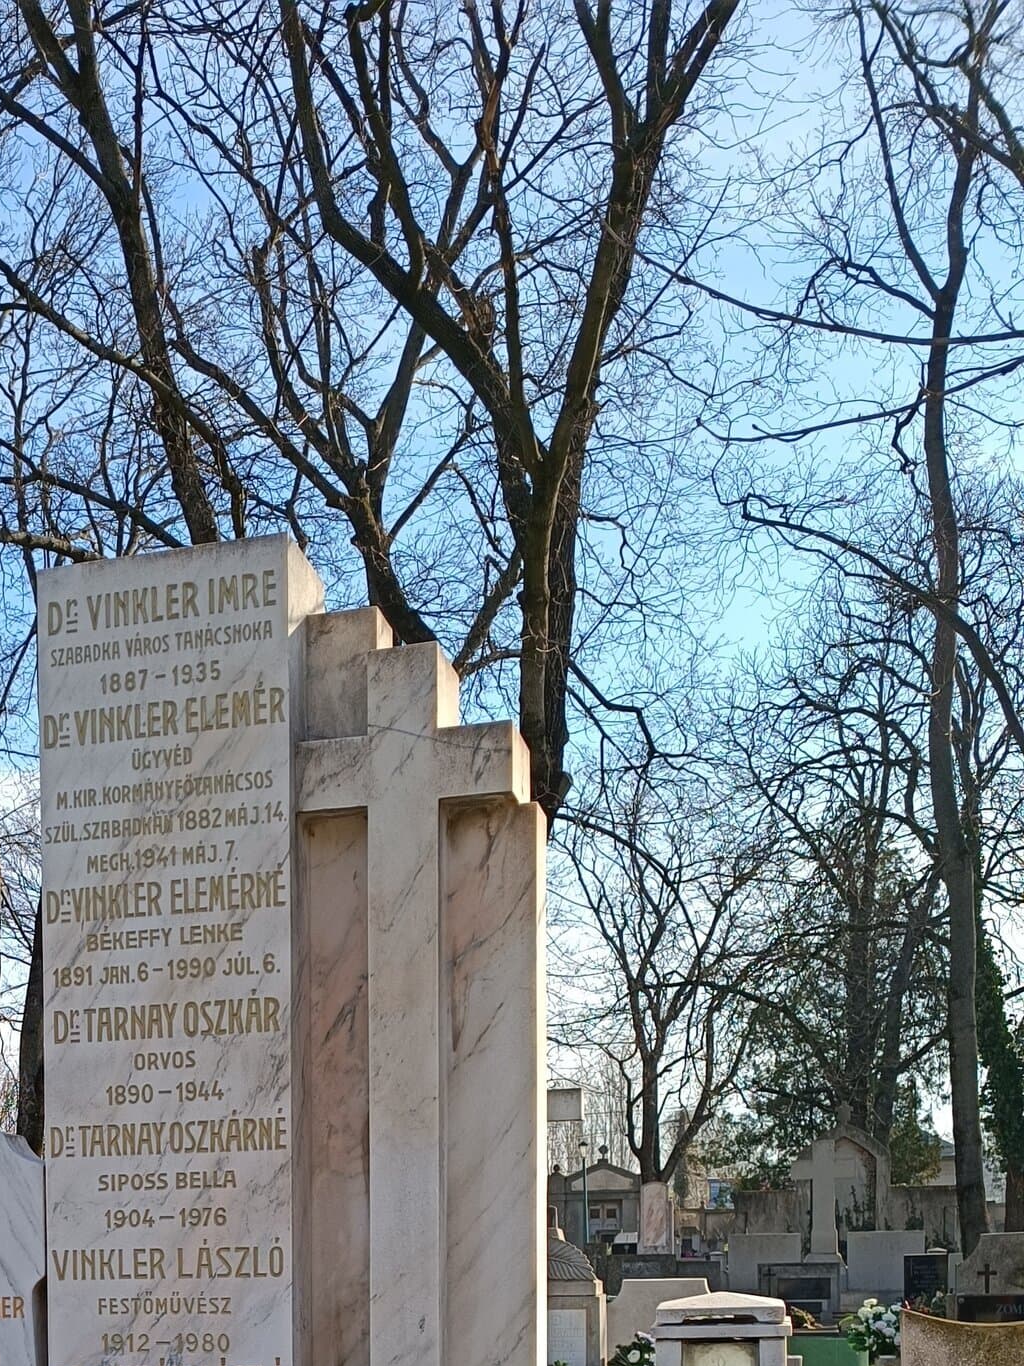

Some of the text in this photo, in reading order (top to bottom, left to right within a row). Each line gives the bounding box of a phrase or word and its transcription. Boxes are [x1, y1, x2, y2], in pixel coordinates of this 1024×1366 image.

[86, 581, 200, 631] VINKLER
[208, 570, 277, 615] IMRE
[50, 620, 273, 667] SZABADKA VÁROS TANÁCSNOKA
[100, 669, 148, 695] 1887
[172, 660, 221, 686] 1935
[74, 700, 179, 746] VINKLER
[184, 681, 286, 733] ELEMÉR
[132, 744, 193, 770] ÜGYVÉD
[177, 808, 222, 832] 1882
[71, 881, 163, 924] VINKLER
[170, 862, 287, 916] ELEMÉRNÉ
[86, 922, 244, 952] BÉKEFFY LENKE
[53, 966, 93, 988] 1891
[167, 957, 217, 980] 1990
[83, 1003, 178, 1042] TARNAY
[183, 988, 281, 1038] OSZKÁR
[134, 1050, 196, 1071] ORVOS
[106, 1084, 154, 1106] 1890
[176, 1080, 224, 1101] 1944
[78, 1122, 166, 1157] TARNAY
[169, 1108, 288, 1154] OSZKÁRNÉ
[98, 1170, 237, 1192] SIPOSS BELLA
[104, 1209, 155, 1228] 1904
[179, 1207, 227, 1227] 1976
[51, 1238, 284, 1281] VINKLER LÁSZLÓ
[101, 1333, 150, 1353] 1912
[175, 1333, 230, 1353] 1980
